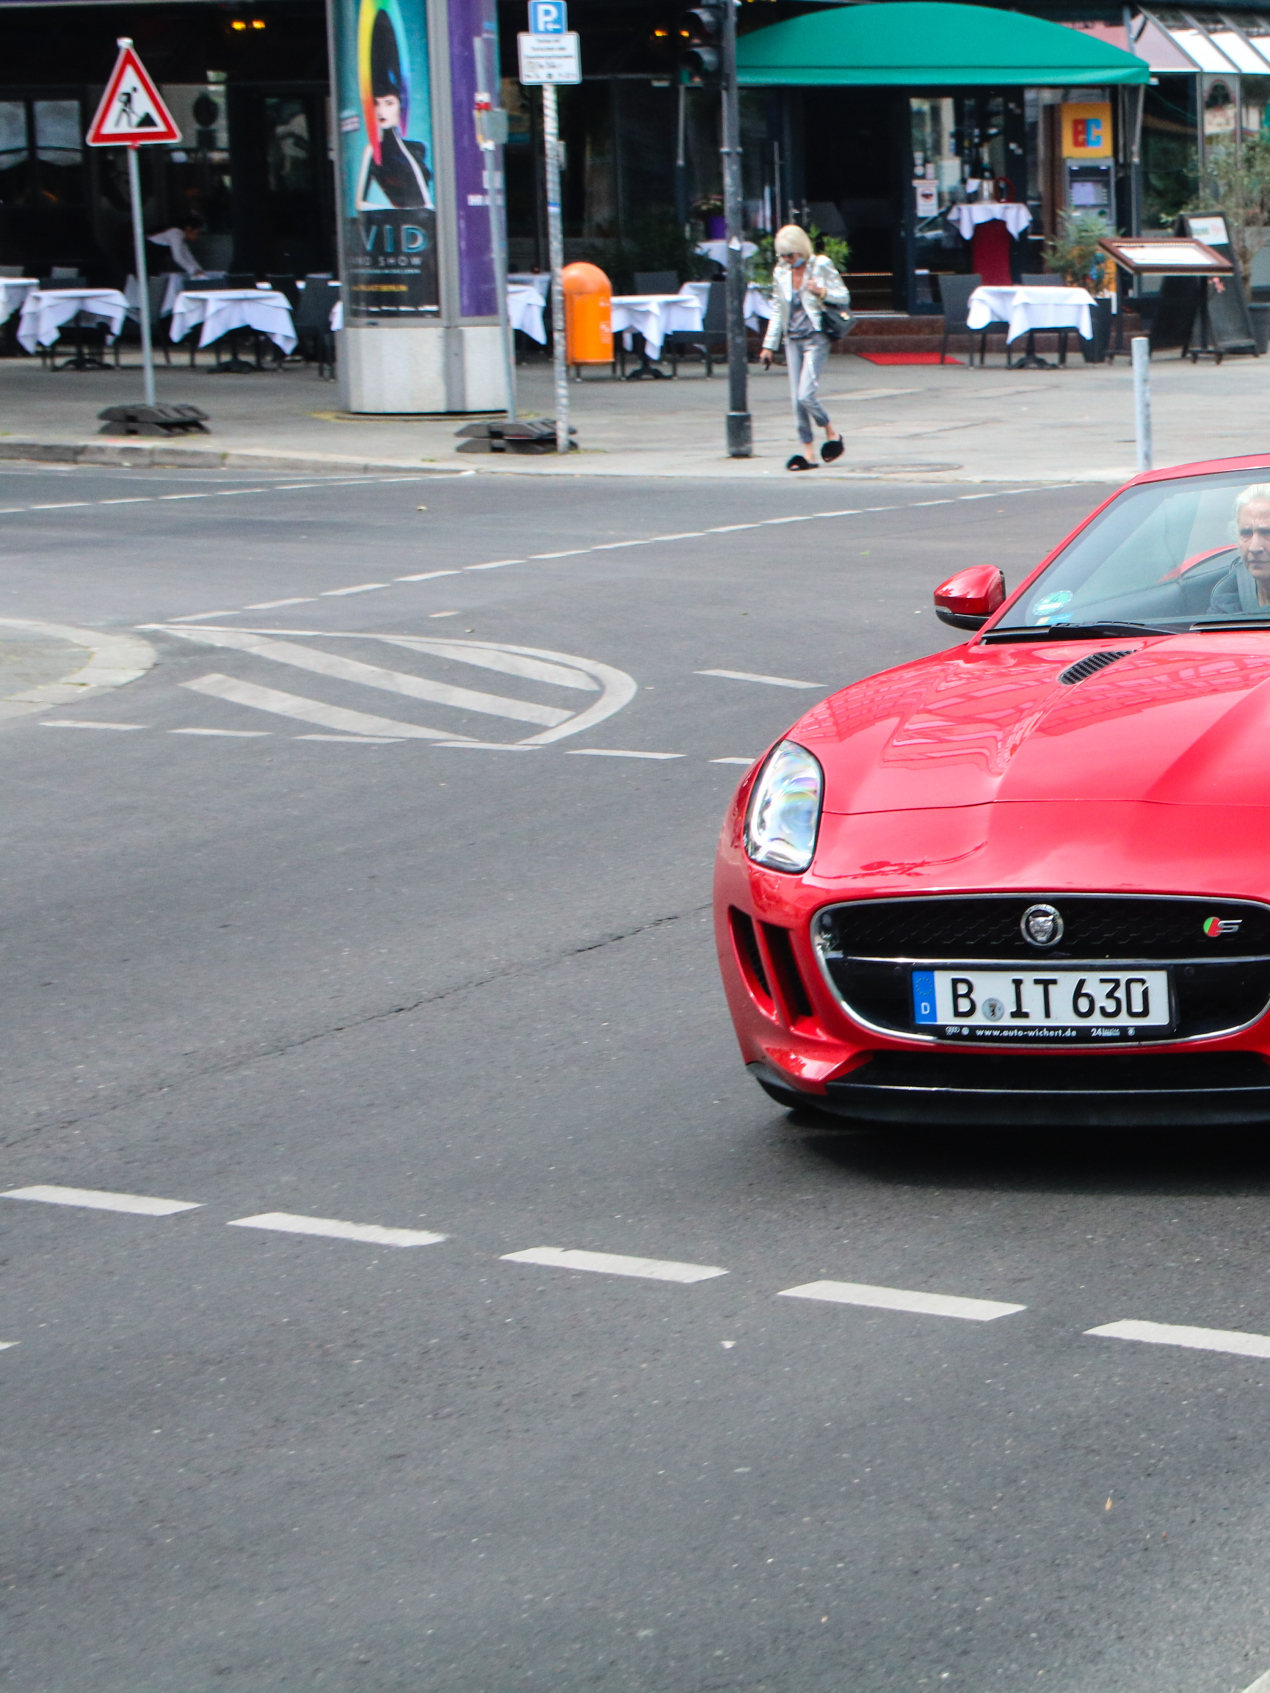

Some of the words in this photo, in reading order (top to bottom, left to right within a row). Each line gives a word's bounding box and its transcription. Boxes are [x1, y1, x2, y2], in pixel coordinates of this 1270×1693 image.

[537, 4, 558, 31] P
[950, 977, 977, 1019] B
[1010, 977, 1058, 1019] IT
[1072, 977, 1150, 1019] 630
[921, 1003, 930, 1015] D
[976, 1027, 1077, 1037] www.auto-wichert.de
